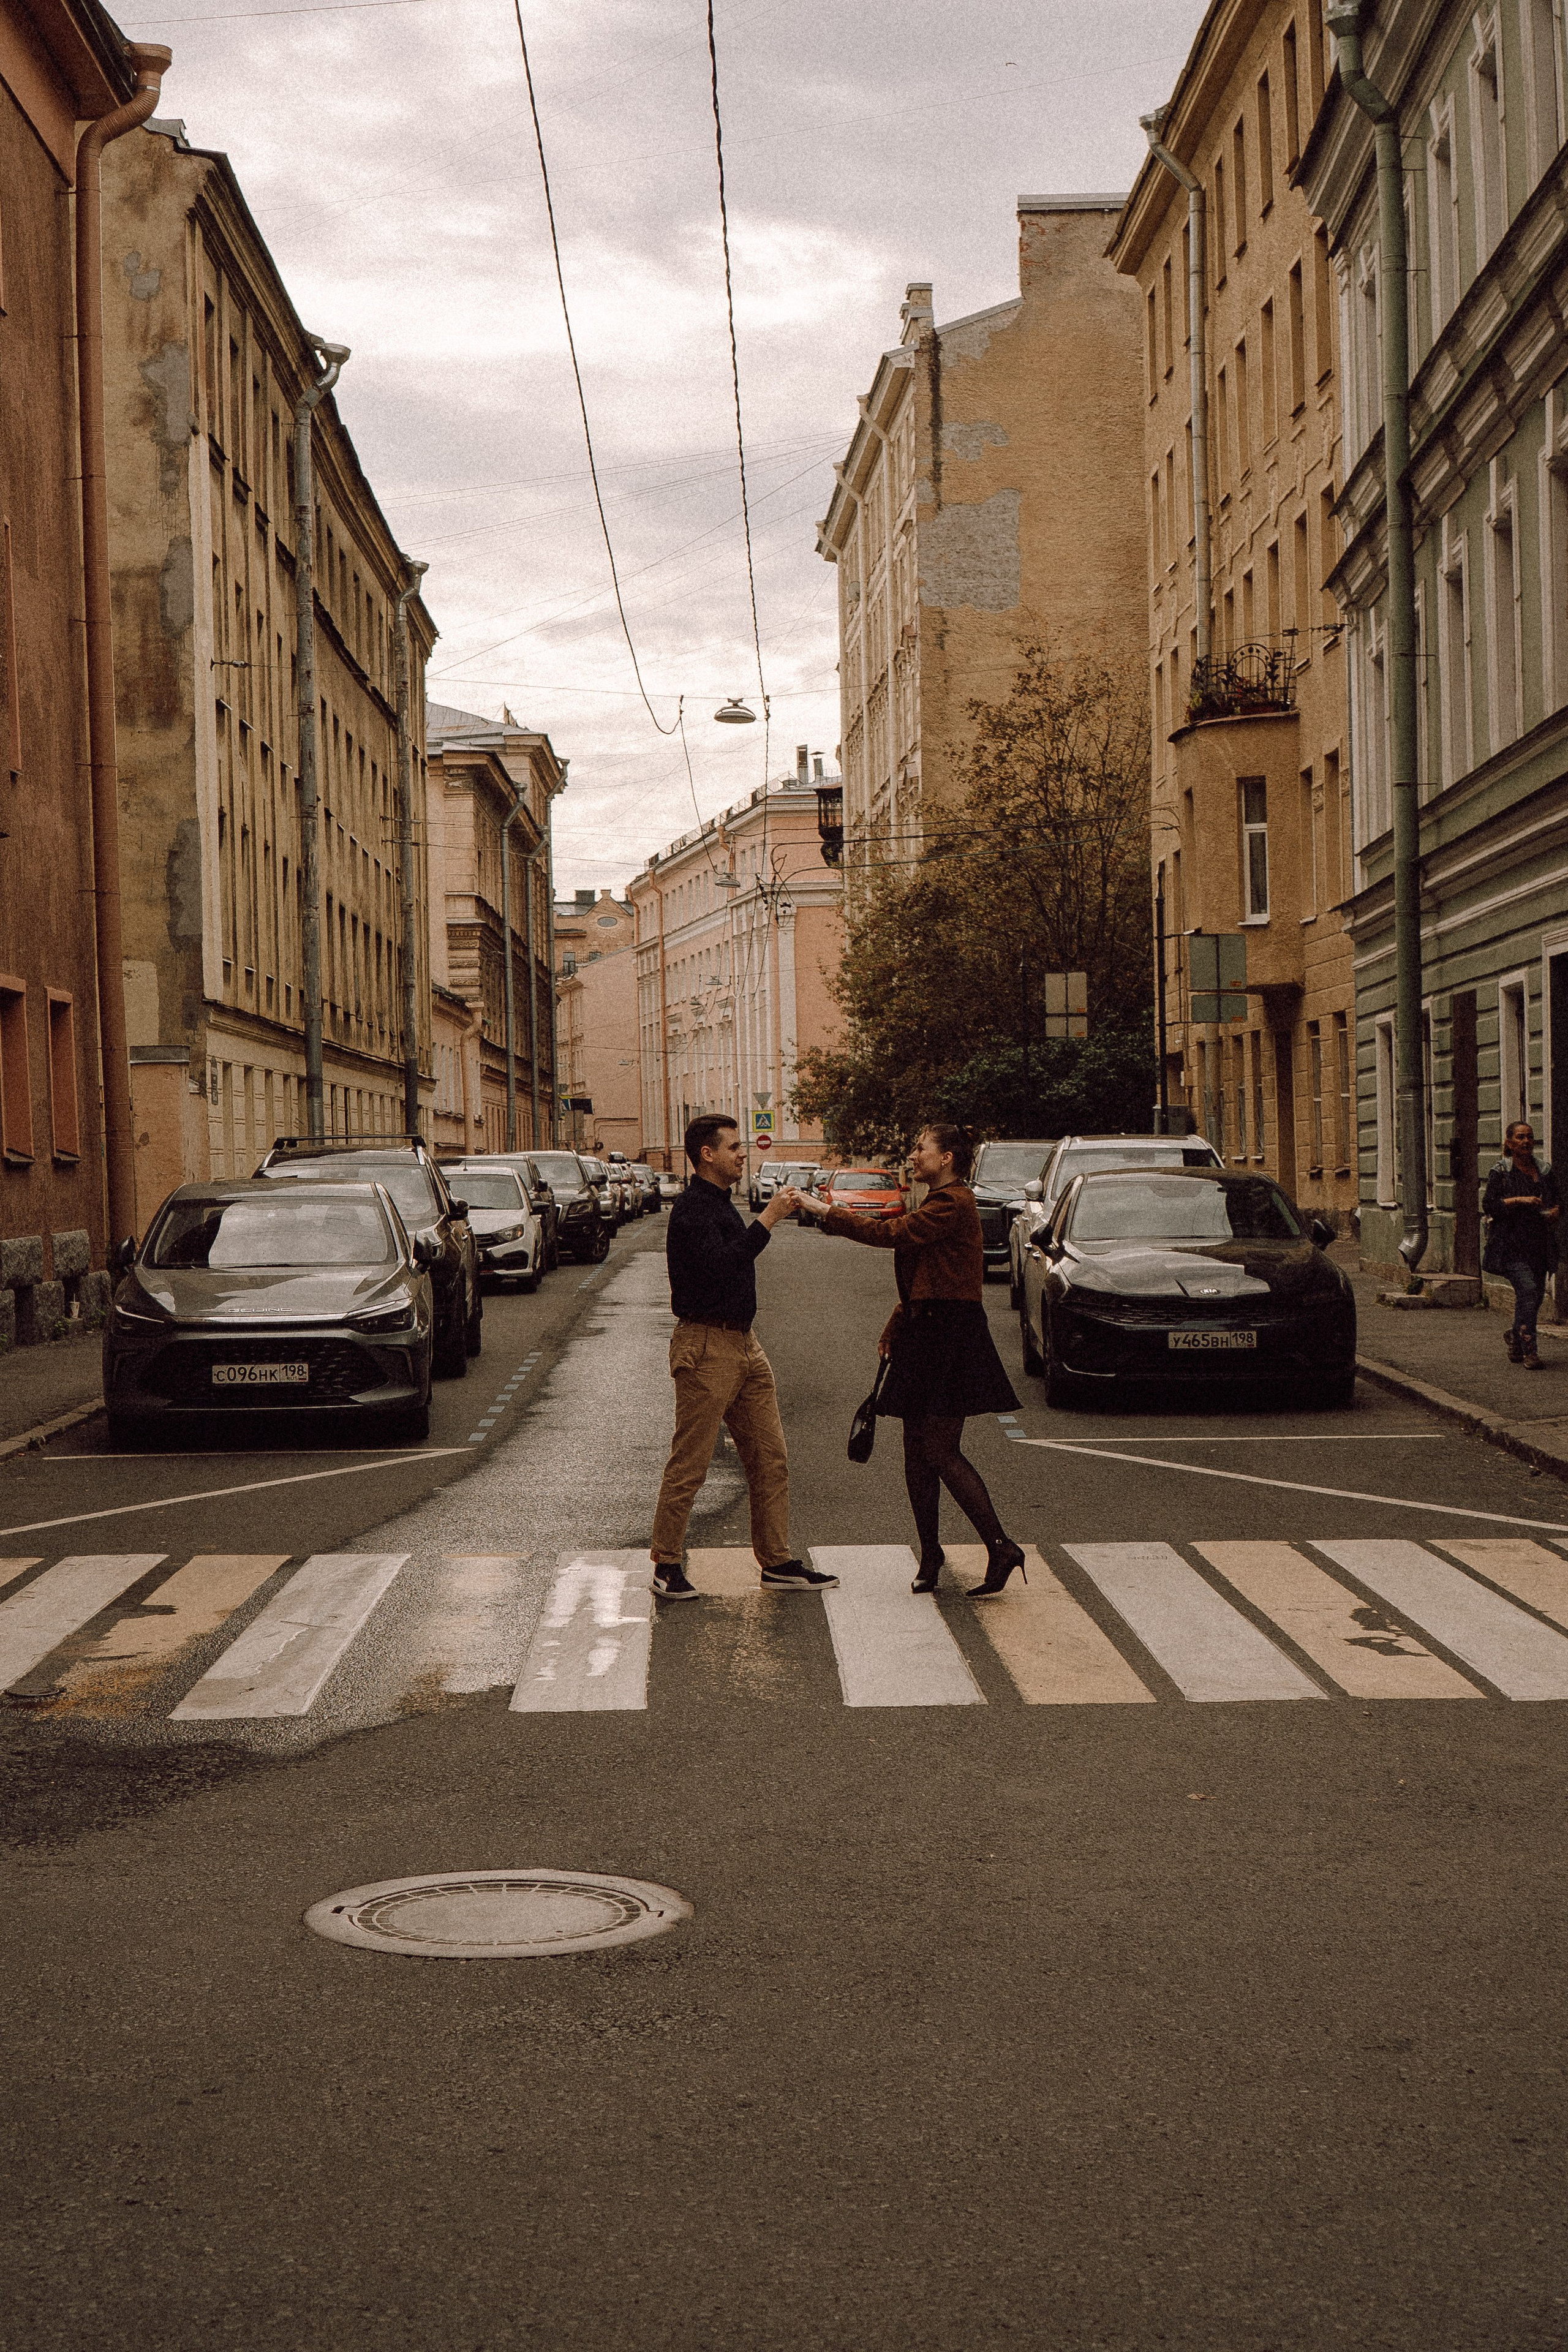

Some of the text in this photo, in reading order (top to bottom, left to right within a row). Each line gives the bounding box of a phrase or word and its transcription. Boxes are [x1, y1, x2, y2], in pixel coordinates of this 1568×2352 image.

[1172, 1333, 1254, 1348] У465ВН 198
[216, 1365, 304, 1382] С096НК 198
